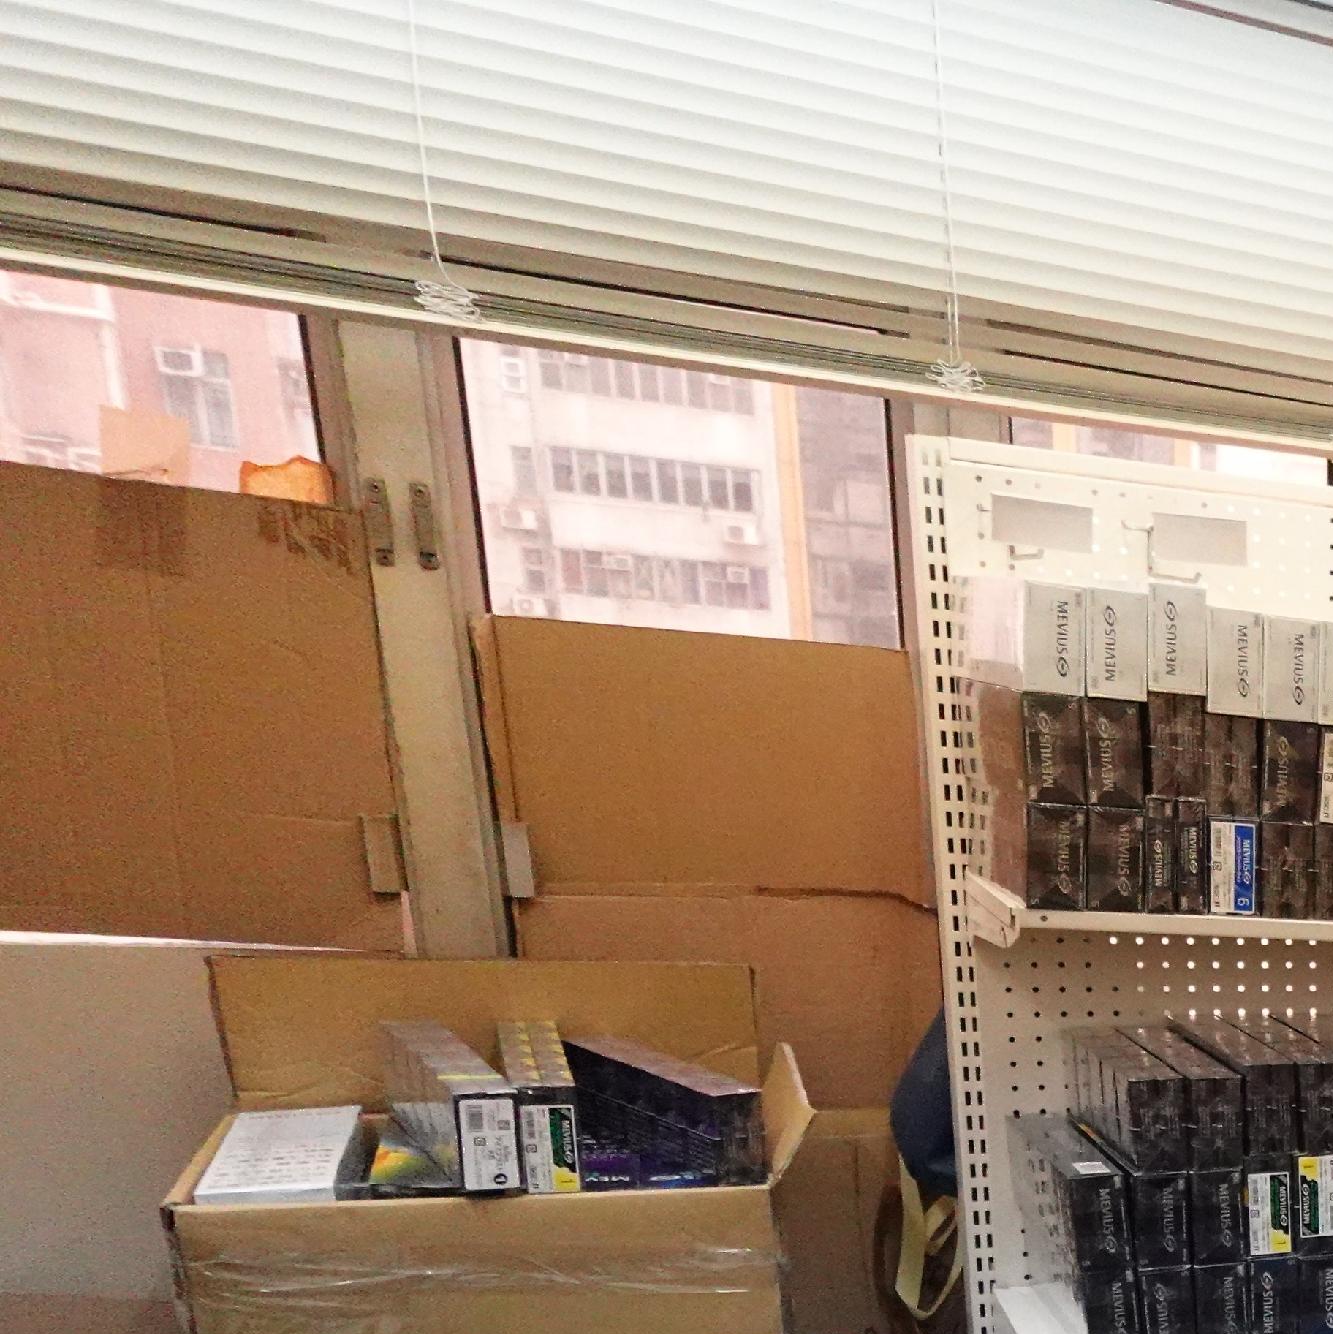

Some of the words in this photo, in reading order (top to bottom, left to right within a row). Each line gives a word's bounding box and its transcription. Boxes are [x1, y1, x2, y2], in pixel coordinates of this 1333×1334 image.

[1055, 602, 1069, 654] MEVIUS
[1166, 623, 1178, 676] MEVIUS
[1237, 625, 1250, 678] MEVIUS
[1105, 629, 1117, 681] MEVIUS
[1294, 634, 1305, 685] MEVIUS
[1039, 735, 1054, 788] MEVIUS
[1099, 739, 1114, 792] MEVIUS
[1058, 821, 1070, 873] MEVIUS
[1118, 824, 1130, 875] MEVIUS
[1243, 839, 1251, 868] MEVIUS
[1237, 898, 1250, 907] 6
[562, 1121, 573, 1153] MEVIUS
[1100, 1188, 1115, 1236] MEVIUS
[1163, 1187, 1175, 1236] MEVIUS
[1219, 1184, 1232, 1232] MEVIUS
[1279, 1187, 1288, 1214] MEVIUS
[1302, 1195, 1311, 1224] MEVIUS
[1112, 1282, 1126, 1329] MEVIUS
[1223, 1277, 1235, 1325] MEVIUS
[1263, 1291, 1274, 1334] MEVIUS
